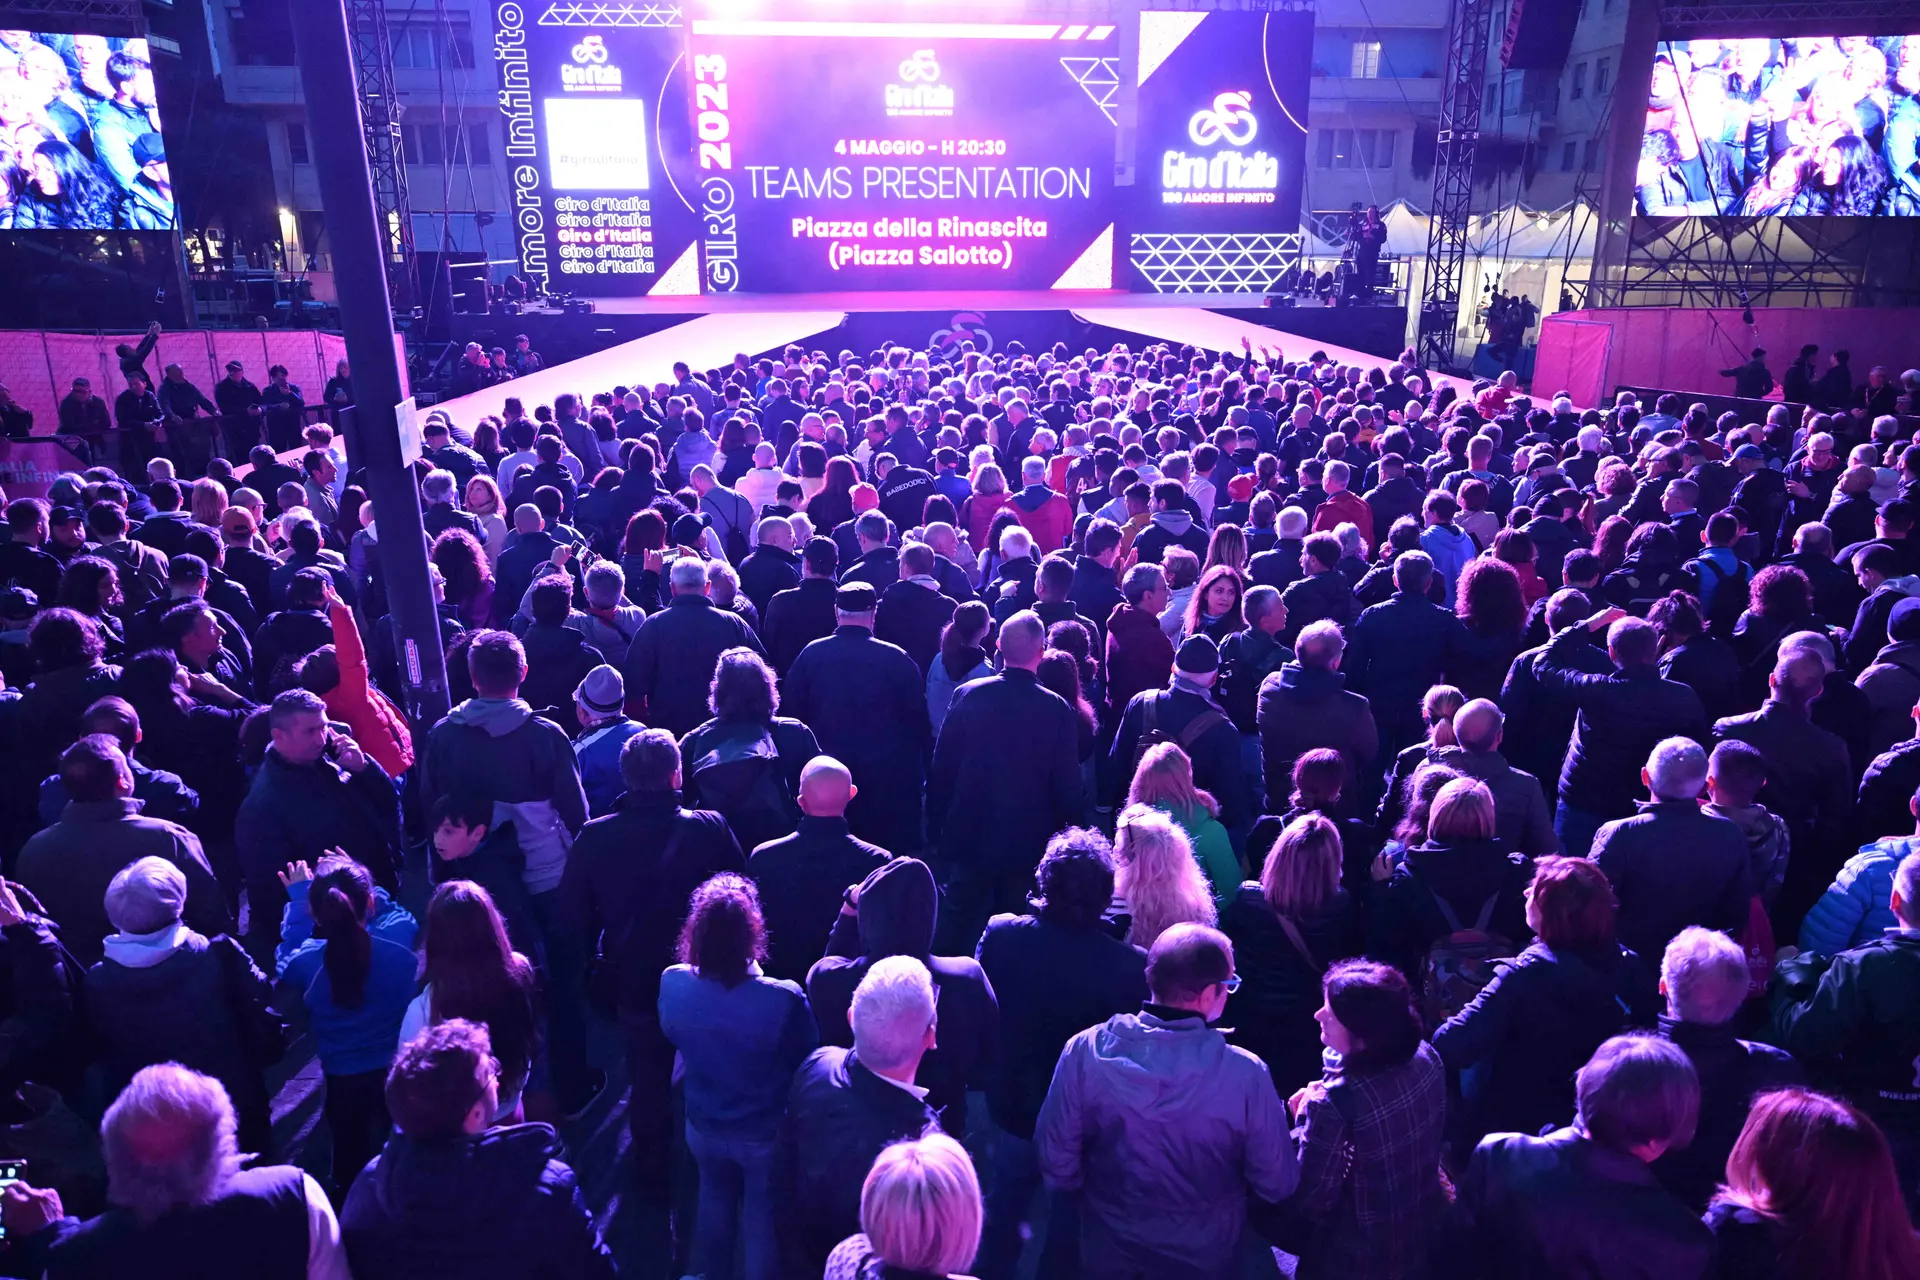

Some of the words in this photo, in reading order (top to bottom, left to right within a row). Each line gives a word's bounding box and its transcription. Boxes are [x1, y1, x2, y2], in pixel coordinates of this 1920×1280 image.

[494, 2, 536, 156] Infinito
[695, 54, 732, 169] 2023
[834, 140, 847, 155] 4
[850, 140, 925, 155] MAGGIO
[941, 140, 955, 155] H
[957, 140, 1006, 155] 20:30
[1163, 150, 1208, 188] Giro
[744, 166, 852, 199] TEAMS
[863, 167, 1090, 199] PRESENTATION
[555, 196, 589, 211] Giro
[591, 196, 650, 211] d'Italia
[1183, 193, 1225, 203] AMORE
[556, 212, 591, 227] Giro
[592, 212, 651, 227] d'Italia
[792, 216, 868, 237] Piazza
[873, 217, 932, 237] della
[938, 216, 1048, 237] Rinascita
[558, 228, 592, 242] Giro
[594, 228, 652, 242] d'Italia
[702, 177, 739, 292] GIRO
[559, 243, 594, 258] Giro
[595, 243, 654, 258] d'Italia
[829, 241, 914, 270] (Piazza
[919, 241, 1013, 270] Salotto)
[561, 259, 595, 274] Giro
[596, 259, 655, 274] d'Italia
[408, 641, 418, 681] 04517
